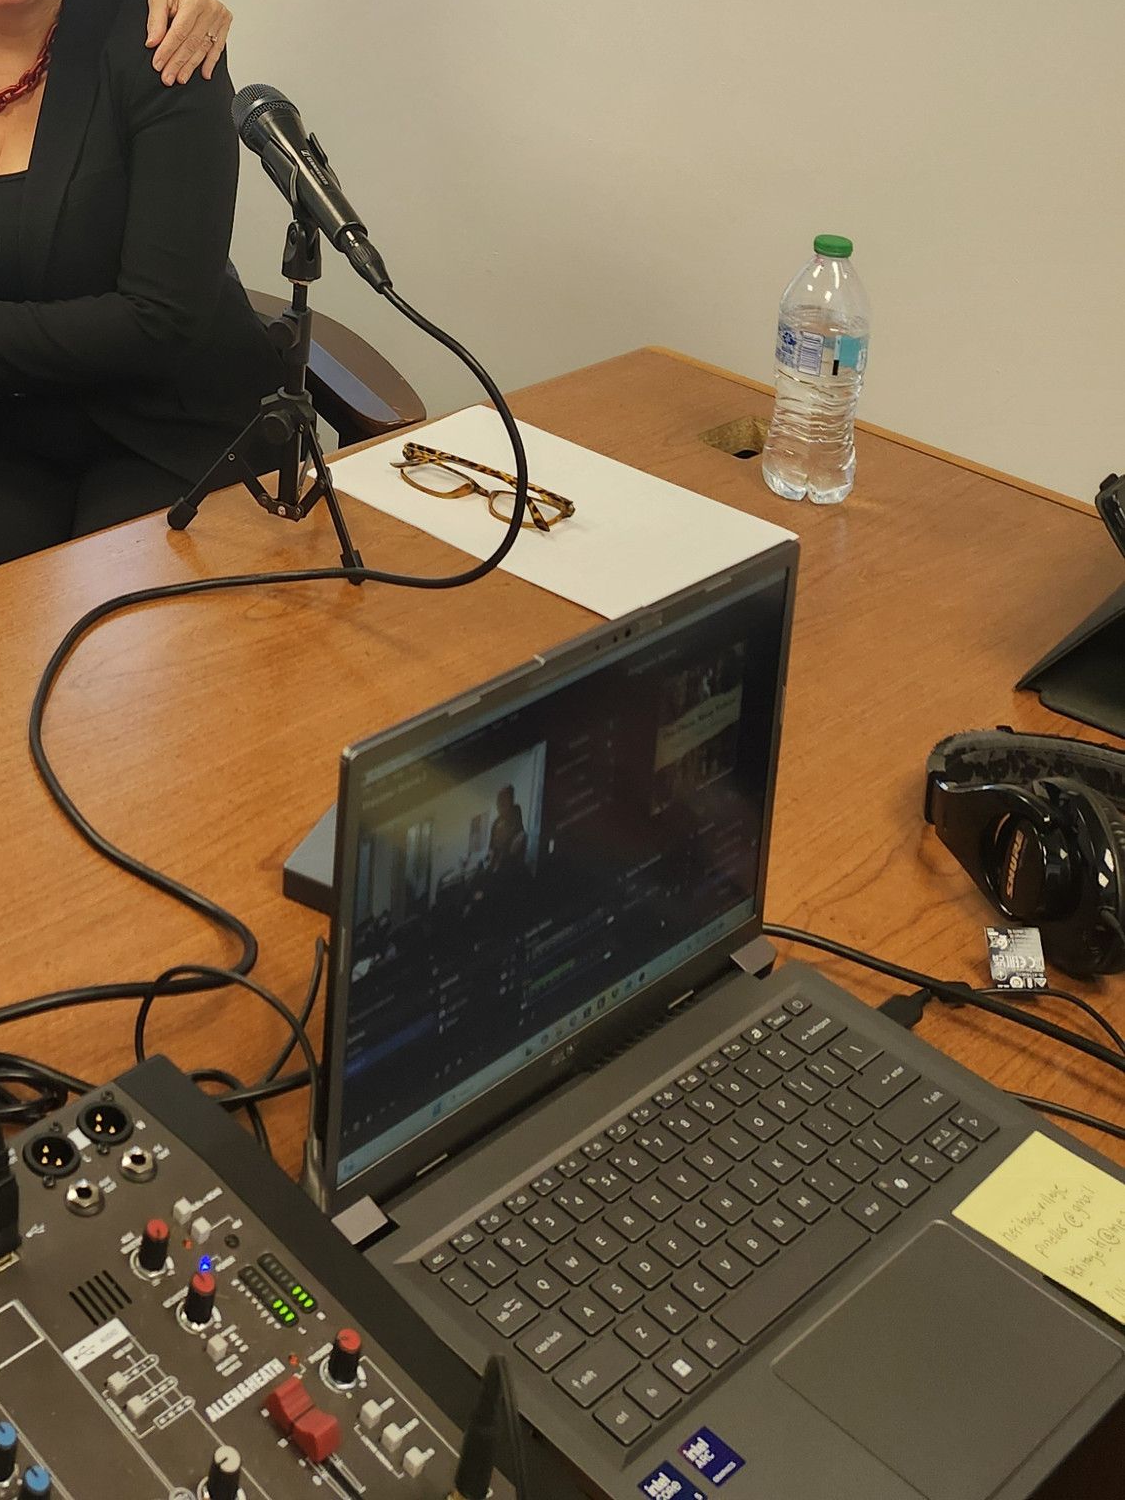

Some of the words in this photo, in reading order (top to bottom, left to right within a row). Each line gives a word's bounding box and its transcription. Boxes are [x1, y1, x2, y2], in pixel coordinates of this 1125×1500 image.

[1006, 829, 1025, 899] SHURE
[537, 1280, 549, 1289] Q
[565, 1257, 578, 1267] W
[596, 1237, 606, 1245] E
[703, 1156, 713, 1164] U
[754, 1118, 763, 1126] O
[584, 1307, 594, 1316] A
[612, 1284, 622, 1293] S
[640, 1262, 650, 1271] D
[668, 1240, 676, 1249] F
[696, 1219, 706, 1228] G
[721, 1199, 732, 1207] H
[772, 1159, 783, 1167] K
[636, 1328, 647, 1338] Z
[665, 1305, 676, 1314] X
[694, 1282, 704, 1291] C
[720, 1260, 730, 1269] V
[747, 1240, 758, 1248] B
[773, 1218, 784, 1226] N
[798, 1197, 810, 1206] M
[534, 1340, 549, 1354] caps
[546, 1330, 562, 1345] lock
[205, 1358, 286, 1423] ALLEN&HEATH
[682, 1436, 710, 1462] intel
[643, 1471, 671, 1497] intel
